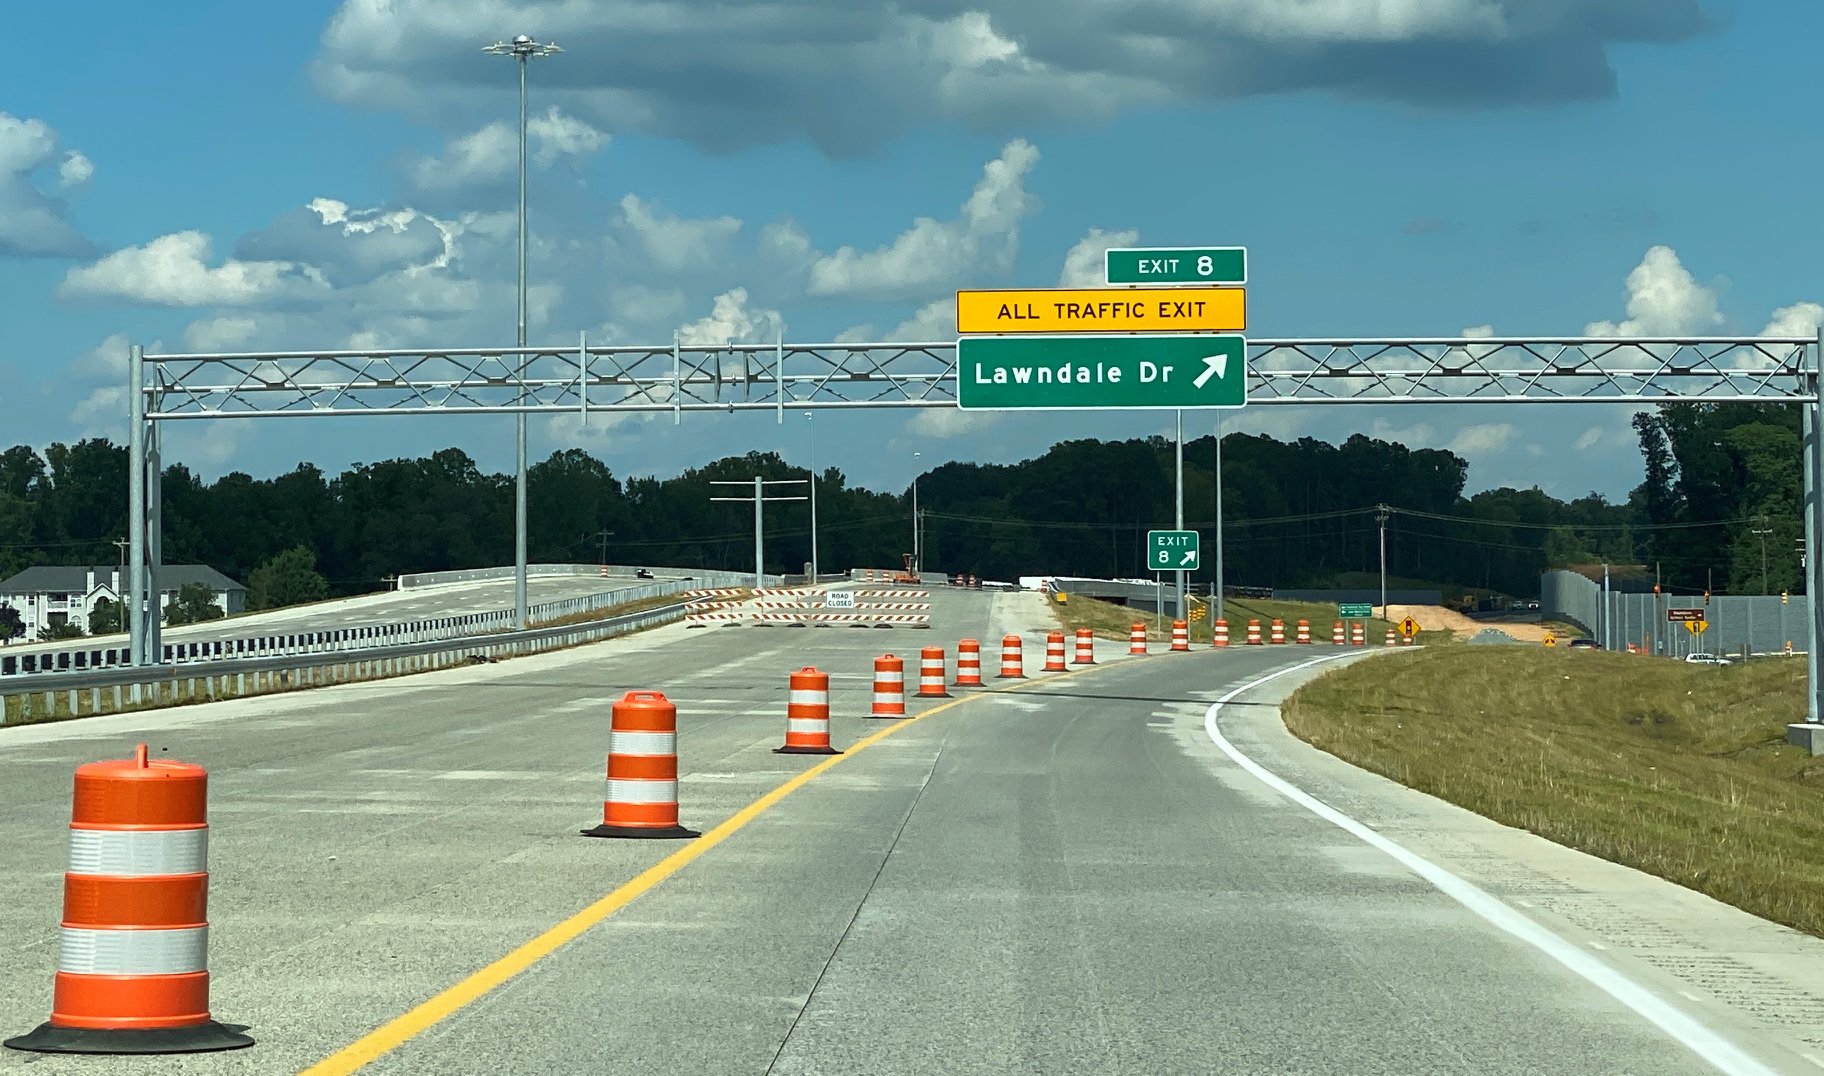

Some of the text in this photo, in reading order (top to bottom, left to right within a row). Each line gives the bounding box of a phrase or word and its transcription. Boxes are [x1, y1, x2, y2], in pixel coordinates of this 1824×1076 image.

[1138, 255, 1214, 276] EXIT 8
[997, 301, 1206, 320] ALL TRAFFIC EXIT
[975, 361, 1174, 385] Lawndale Dr
[1157, 536, 1189, 546] EXIT
[1158, 550, 1169, 563] 8
